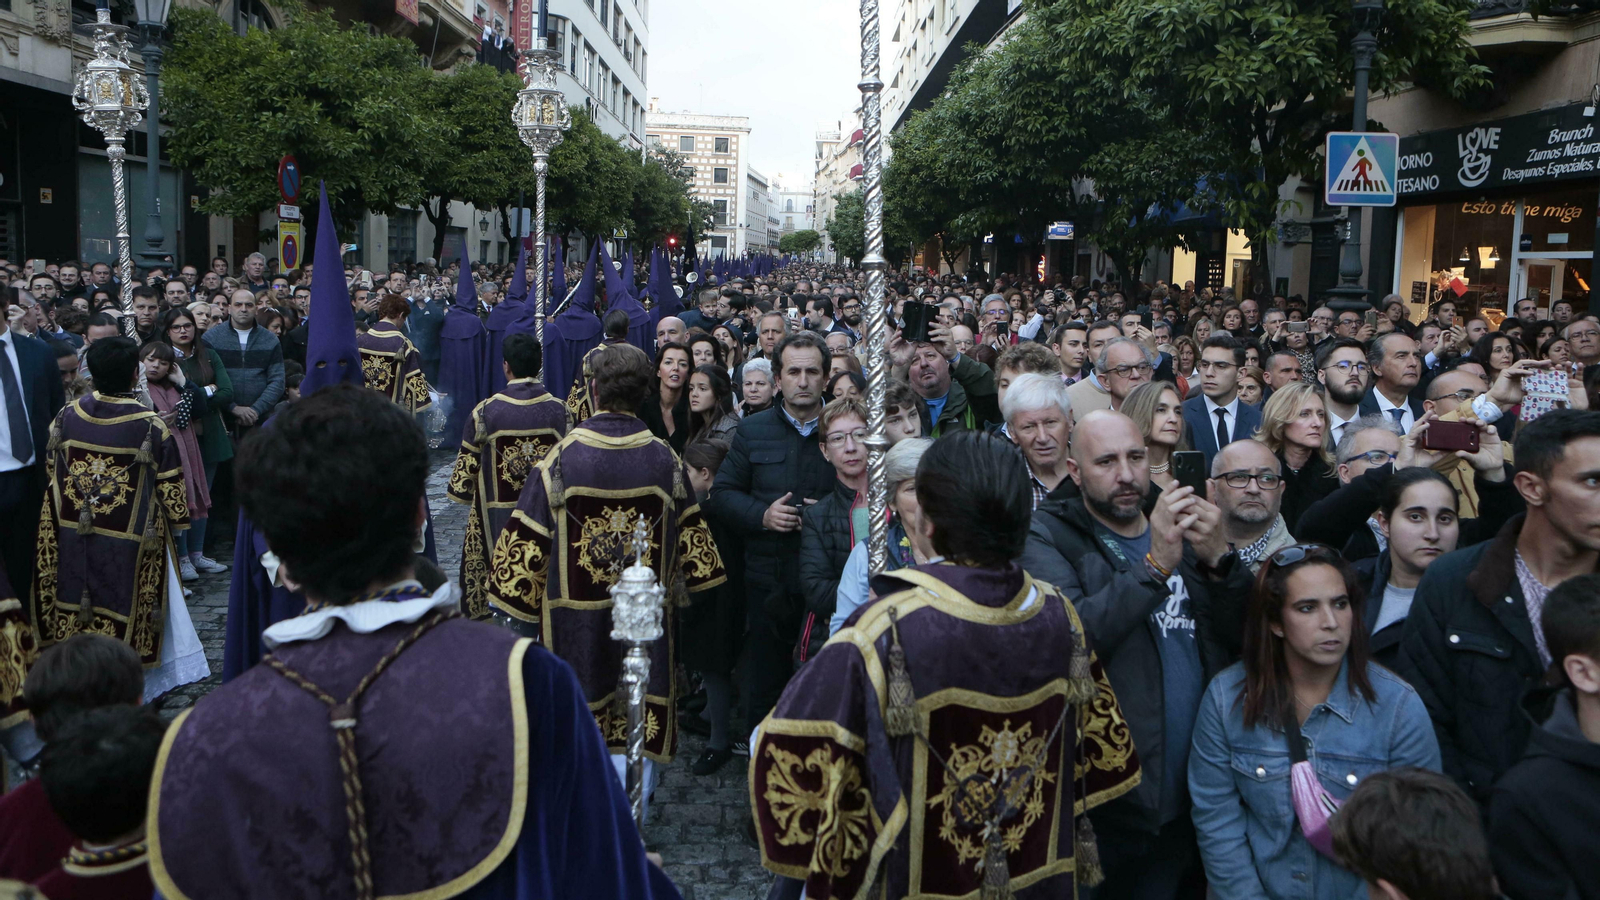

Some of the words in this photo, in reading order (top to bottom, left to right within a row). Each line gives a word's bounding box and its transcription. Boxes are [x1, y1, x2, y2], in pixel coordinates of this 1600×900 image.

[1457, 127, 1501, 158] LOVE
[1547, 123, 1594, 144] Brunch
[1526, 148, 1562, 163] Zumos
[1563, 142, 1600, 157] Natura
[1502, 167, 1546, 182] Desayunos
[1546, 158, 1594, 178] Especiales,
[1397, 174, 1439, 193] TESANO
[1461, 200, 1496, 214] Esto
[1543, 202, 1583, 223] miga
